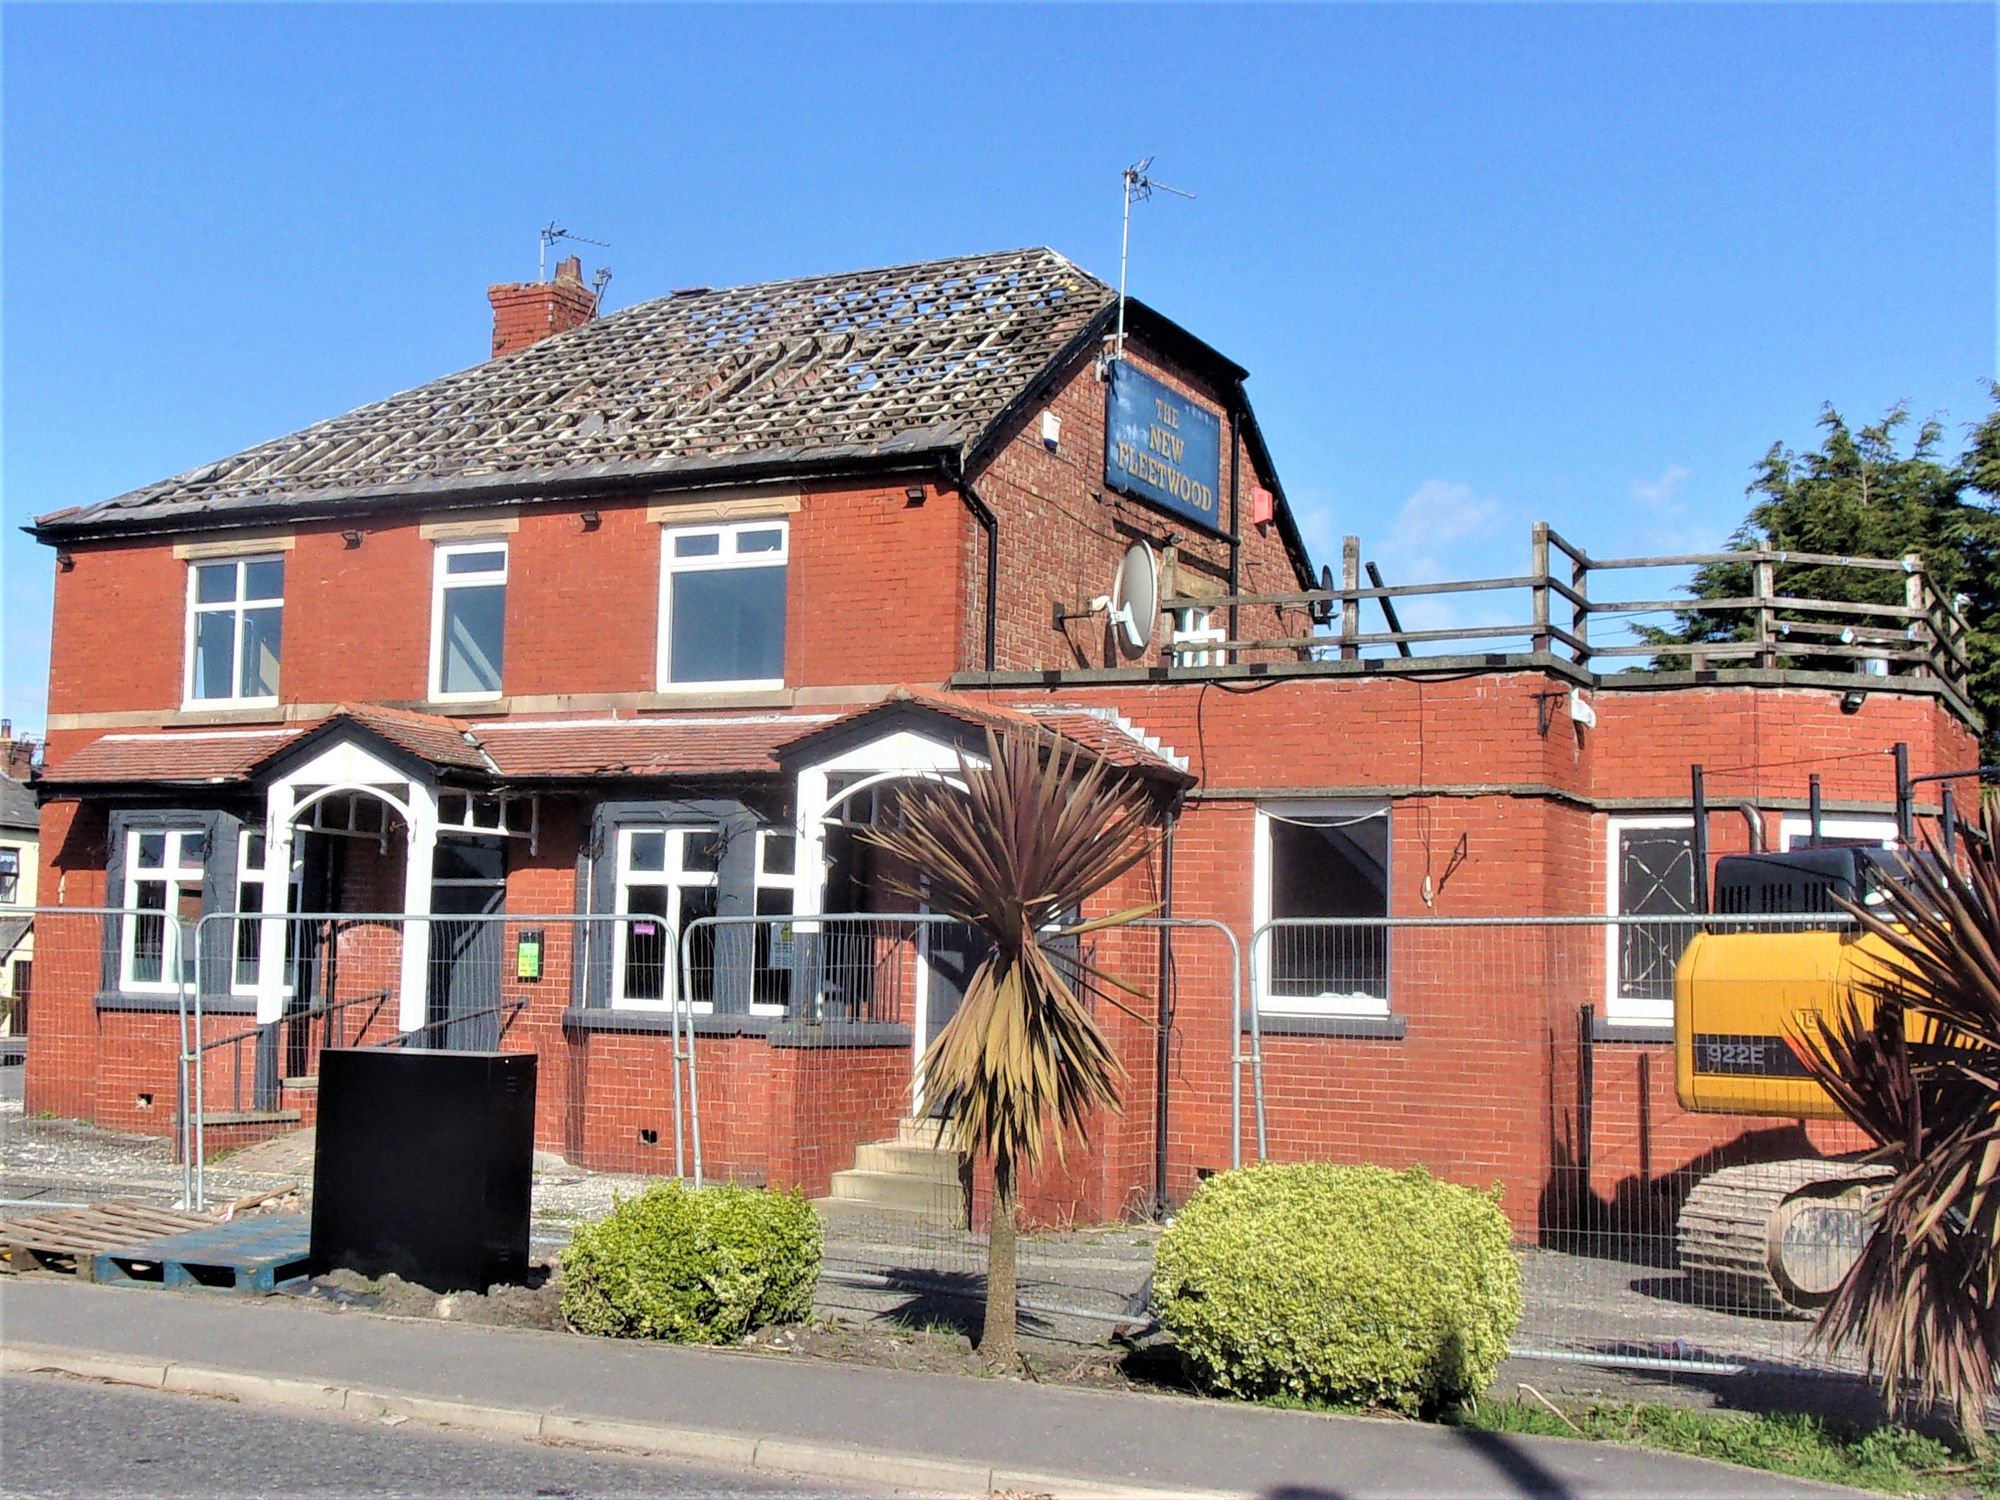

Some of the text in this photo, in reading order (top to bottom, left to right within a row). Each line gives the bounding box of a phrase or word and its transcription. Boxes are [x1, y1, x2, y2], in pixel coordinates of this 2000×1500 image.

[1155, 399, 1179, 429] THE
[1150, 424, 1184, 464] NEW
[1118, 442, 1211, 511] FLEETWOOD
[1708, 1045, 1764, 1064] 922E
